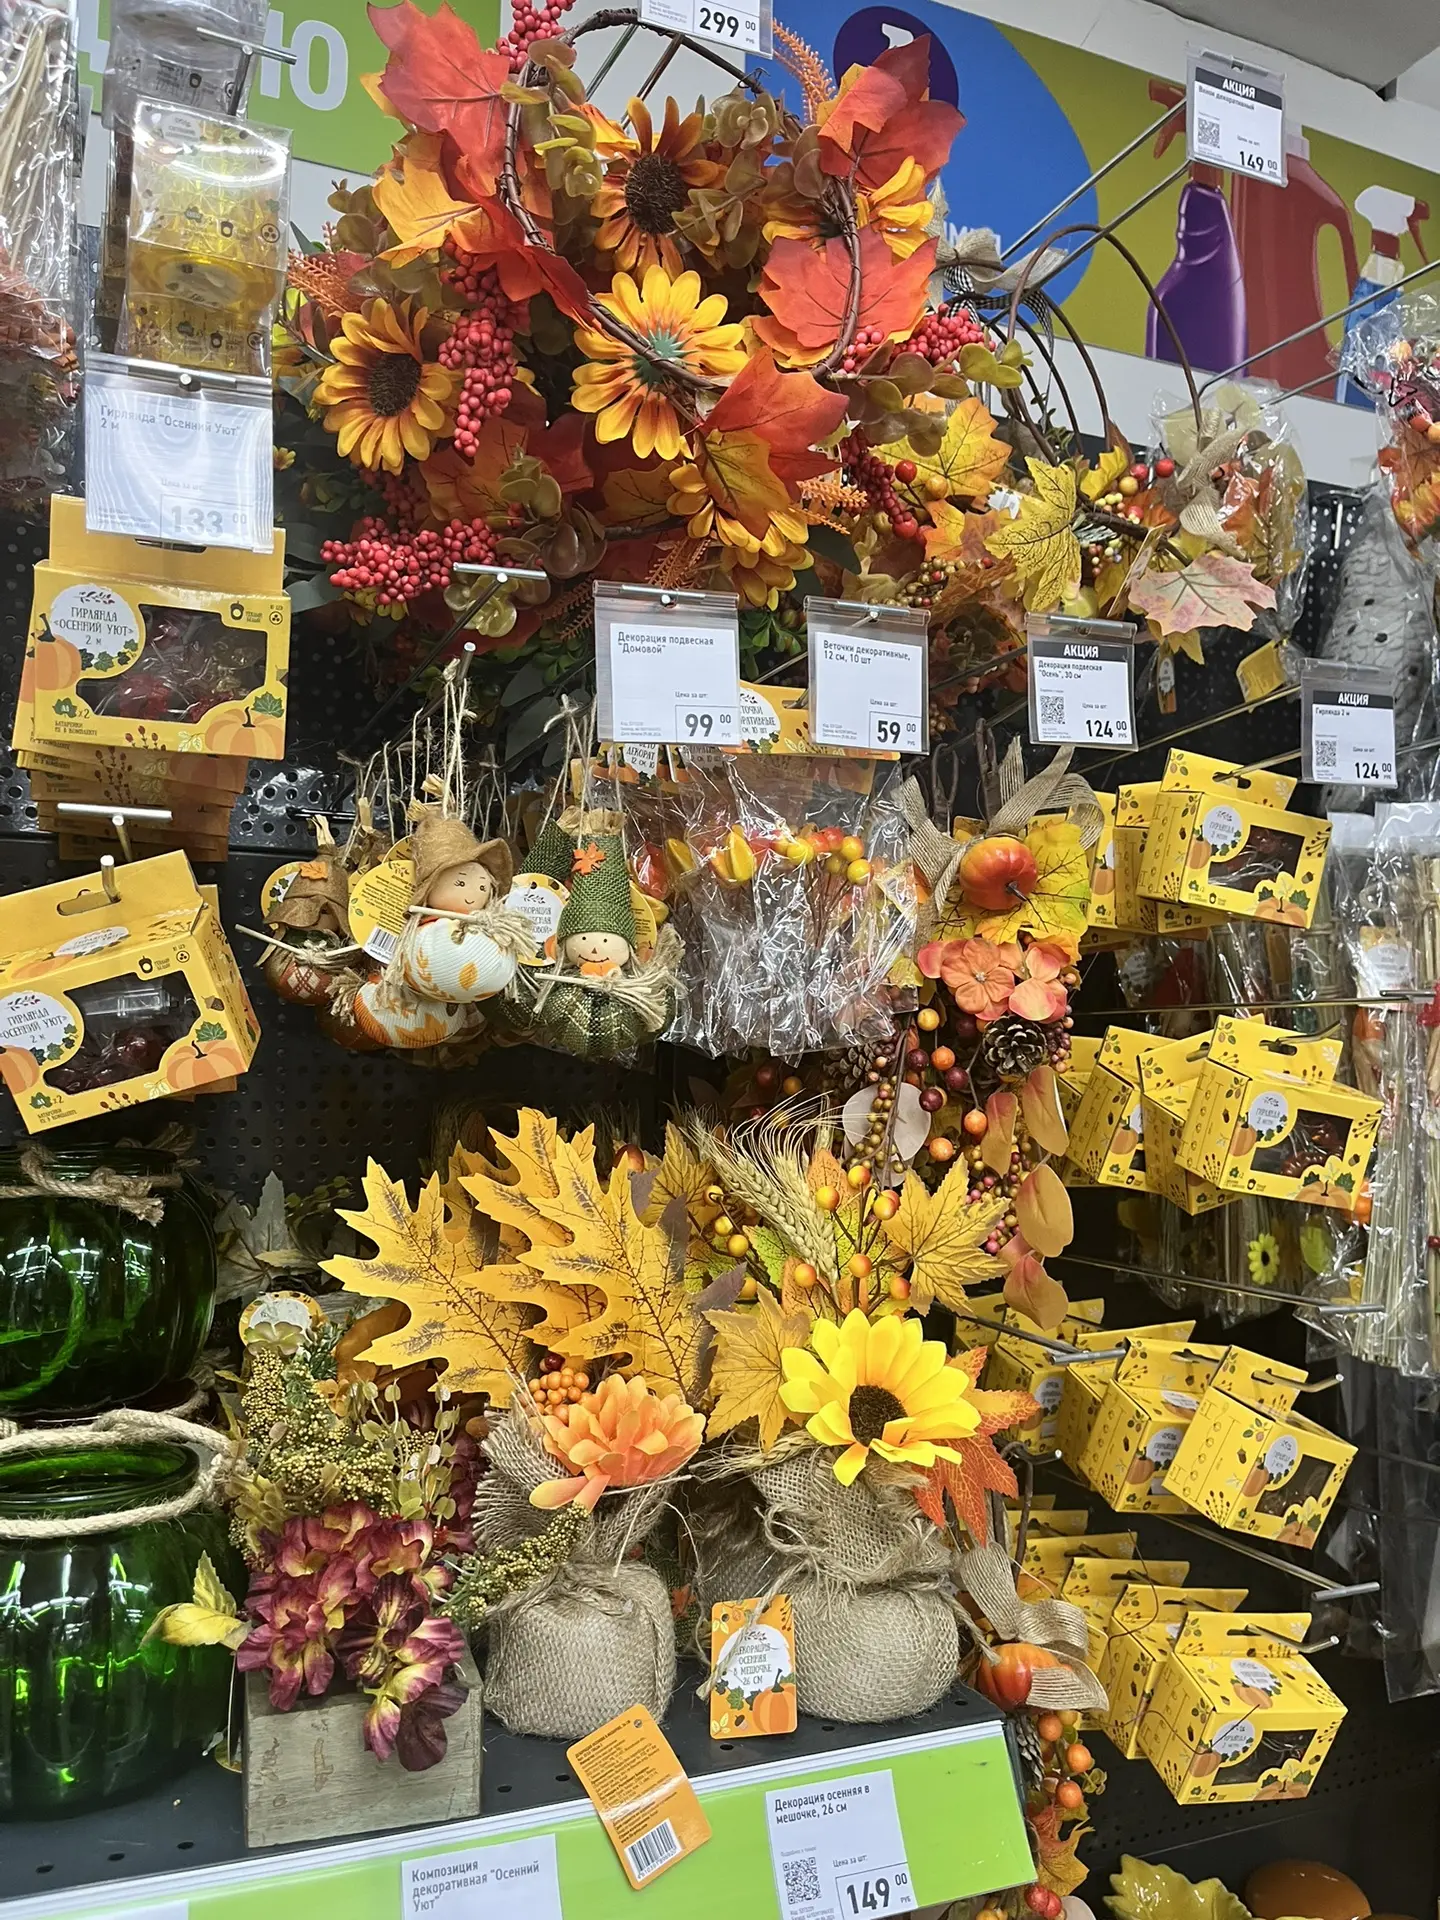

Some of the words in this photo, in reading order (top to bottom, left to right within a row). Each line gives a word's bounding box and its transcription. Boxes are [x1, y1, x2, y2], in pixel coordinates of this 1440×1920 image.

[699, 7, 739, 38] 299
[745, 20, 756, 31] 00
[1222, 78, 1256, 99] АКЦИЯ
[1215, 93, 1255, 111] декоративный
[1239, 151, 1264, 172] 149
[1267, 159, 1278, 171] 00
[101, 405, 156, 424] Гирлянда
[158, 414, 212, 433] "Осенний
[214, 423, 241, 437] Уют"
[101, 418, 107, 429] 2
[111, 422, 120, 431] м
[171, 505, 223, 538] 133
[232, 513, 247, 525] 00
[71, 606, 118, 622] ГИРЛЯНДА
[85, 634, 92, 645] 2
[618, 631, 667, 645] Декорация
[669, 635, 714, 646] подвесная
[618, 642, 666, 654] "Домовой"
[823, 639, 854, 652] Веточки
[856, 645, 911, 662] декоративные,
[1063, 644, 1099, 659] АКЦИЯ
[824, 650, 834, 660] 12
[835, 653, 848, 663] см,
[850, 653, 860, 663] 10
[861, 657, 872, 665] шт
[1038, 660, 1071, 673] Декорация
[1071, 664, 1102, 672] подвесная
[1038, 669, 1064, 680] "Осень",
[1065, 670, 1072, 679] 30
[675, 691, 690, 699] Цена
[1338, 692, 1369, 706] АКЦИЯ
[869, 699, 883, 707] Цена
[740, 705, 763, 715] ТОЧКИ
[1315, 707, 1340, 716] Гирлянда
[1341, 708, 1345, 716] 2
[719, 713, 732, 724] 00
[740, 715, 777, 727] РАТИВНЫЕ
[685, 713, 713, 738] 99
[877, 719, 901, 745] 59
[906, 722, 917, 733] 00
[1086, 719, 1114, 738] 124
[1116, 720, 1127, 731] 00
[625, 748, 656, 760] ДЕКОРАТ
[1354, 762, 1380, 779] 124
[1381, 762, 1392, 772] 00
[6, 1007, 51, 1026] ГИРЛЯНДА
[29, 1034, 37, 1044] 2
[738, 1642, 771, 1655] ЕКОРАЦИЯ
[738, 1655, 767, 1665] ОСЕННЯЯ
[740, 1663, 772, 1676] МЕШОЧКЕ
[752, 1674, 763, 1684] СМ
[774, 1793, 825, 1812] Декорация
[827, 1786, 863, 1801] осенняя
[864, 1785, 870, 1794] в
[776, 1807, 821, 1825] мешочке,
[822, 1803, 834, 1816] 26
[836, 1803, 848, 1812] см
[833, 1858, 849, 1868] Цена
[412, 1861, 479, 1883] Композиция
[412, 1873, 488, 1900] декоративная
[490, 1860, 540, 1881] "Осенний
[895, 1872, 908, 1886] 00
[846, 1877, 891, 1915] 149
[900, 1895, 912, 1904] РУБ
[413, 1895, 440, 1912] Уют"
